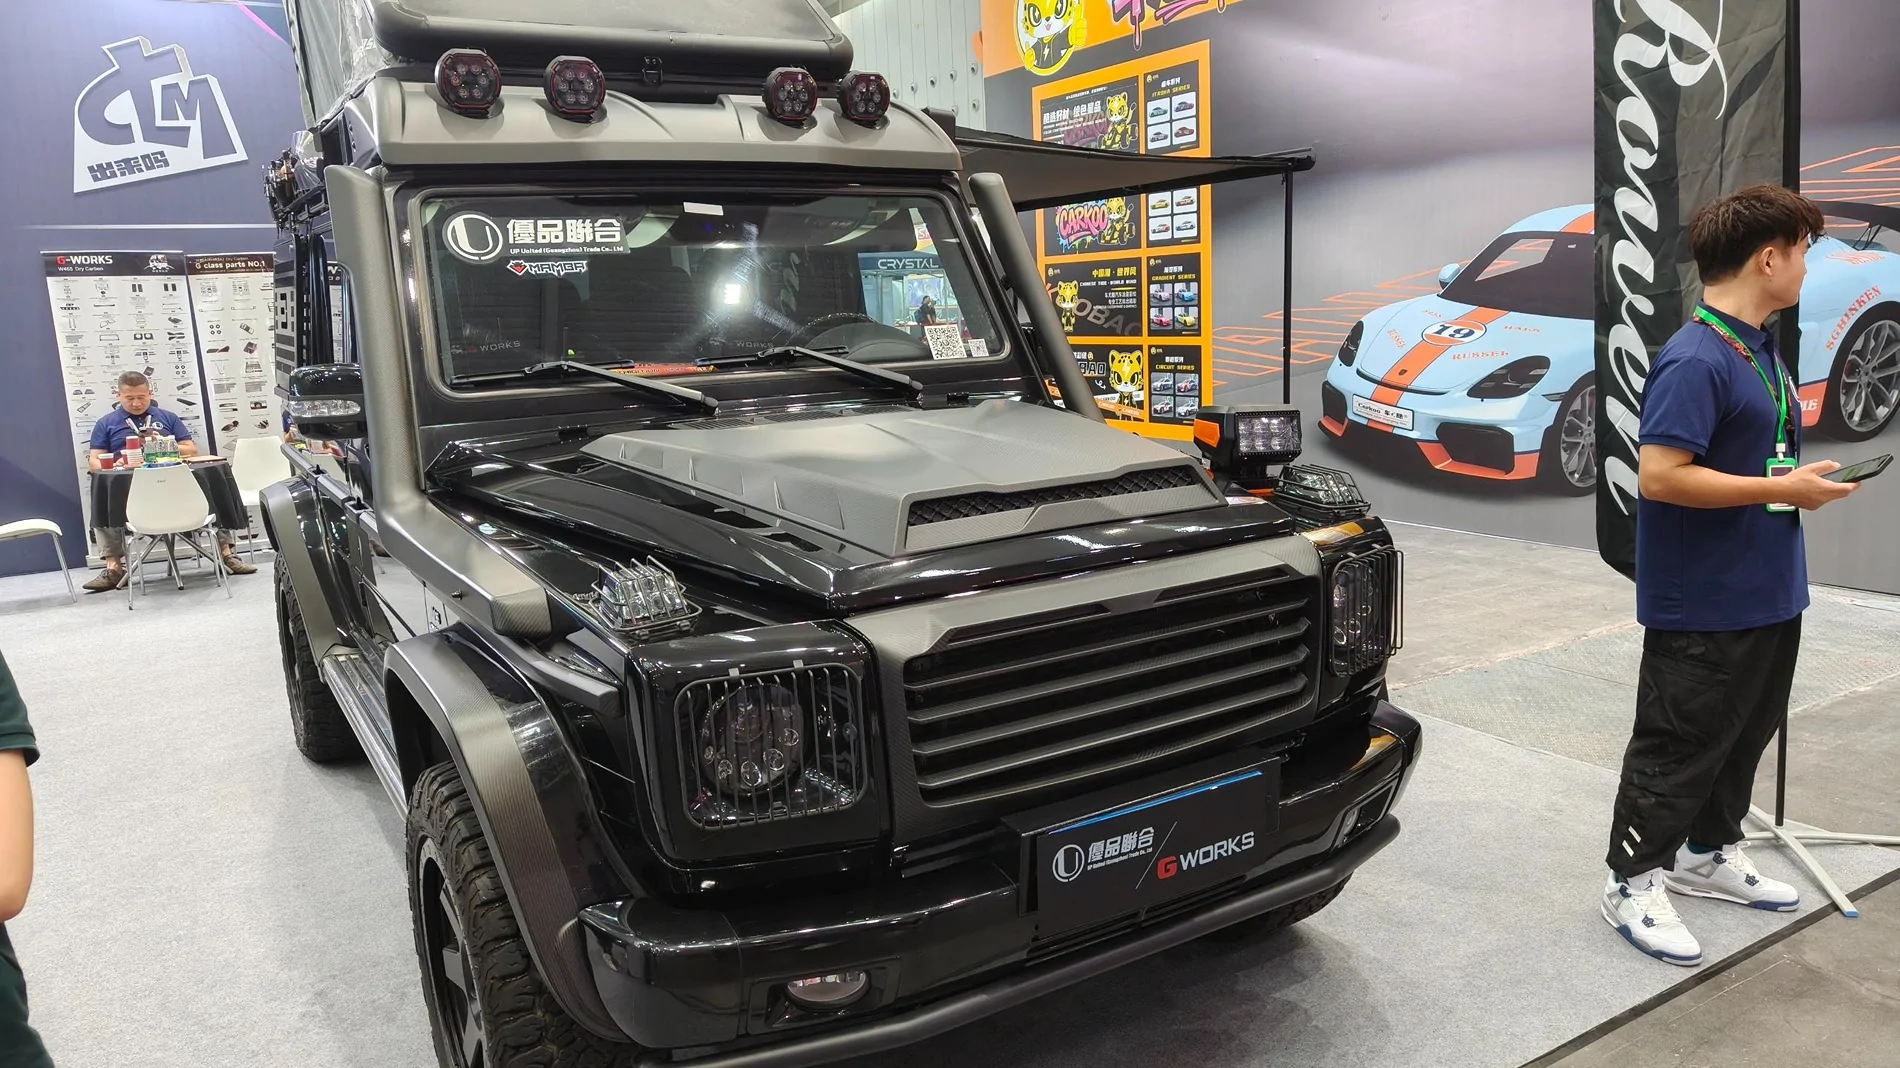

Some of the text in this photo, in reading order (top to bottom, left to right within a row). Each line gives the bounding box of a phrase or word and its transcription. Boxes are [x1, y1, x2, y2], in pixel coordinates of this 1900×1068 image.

[1059, 203, 1109, 237] CARKOO
[507, 218, 622, 244] 優品聯合
[56, 255, 113, 265] G-WORKS
[225, 261, 246, 270] parts
[248, 260, 265, 268] NO.1
[877, 258, 939, 269] CRYSTAL
[528, 260, 588, 277] MAMBA
[1433, 324, 1475, 339] 19
[480, 340, 521, 351] WORKS
[1088, 826, 1155, 863] 優品聯合
[1157, 831, 1255, 880] G WORKS
